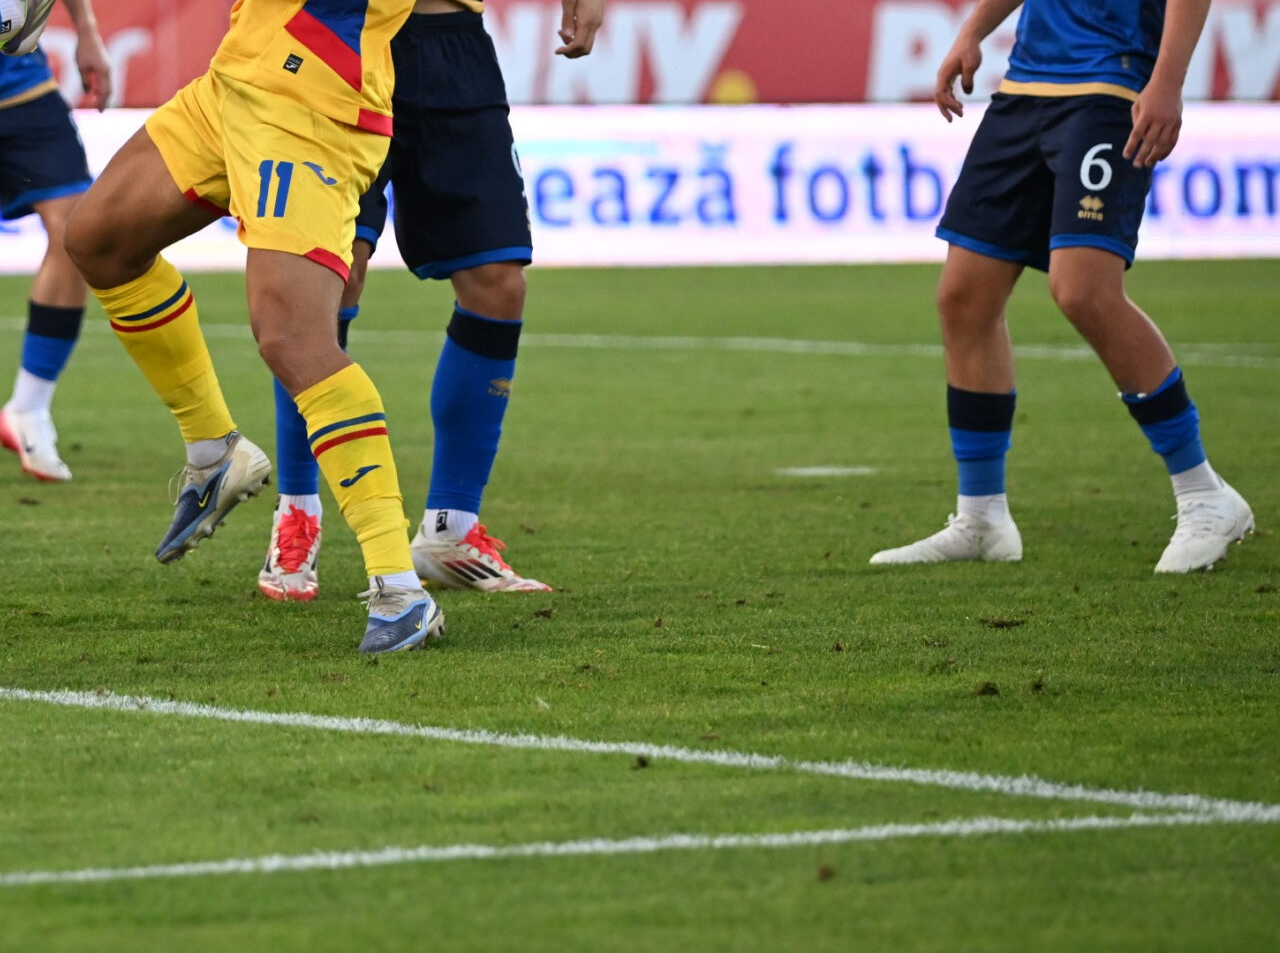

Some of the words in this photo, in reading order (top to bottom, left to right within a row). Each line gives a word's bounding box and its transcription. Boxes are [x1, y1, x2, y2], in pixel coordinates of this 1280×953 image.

[256, 159, 294, 218] 11
[534, 142, 737, 227] ează
[767, 141, 944, 224] fotb
[1079, 142, 1113, 191] 6
